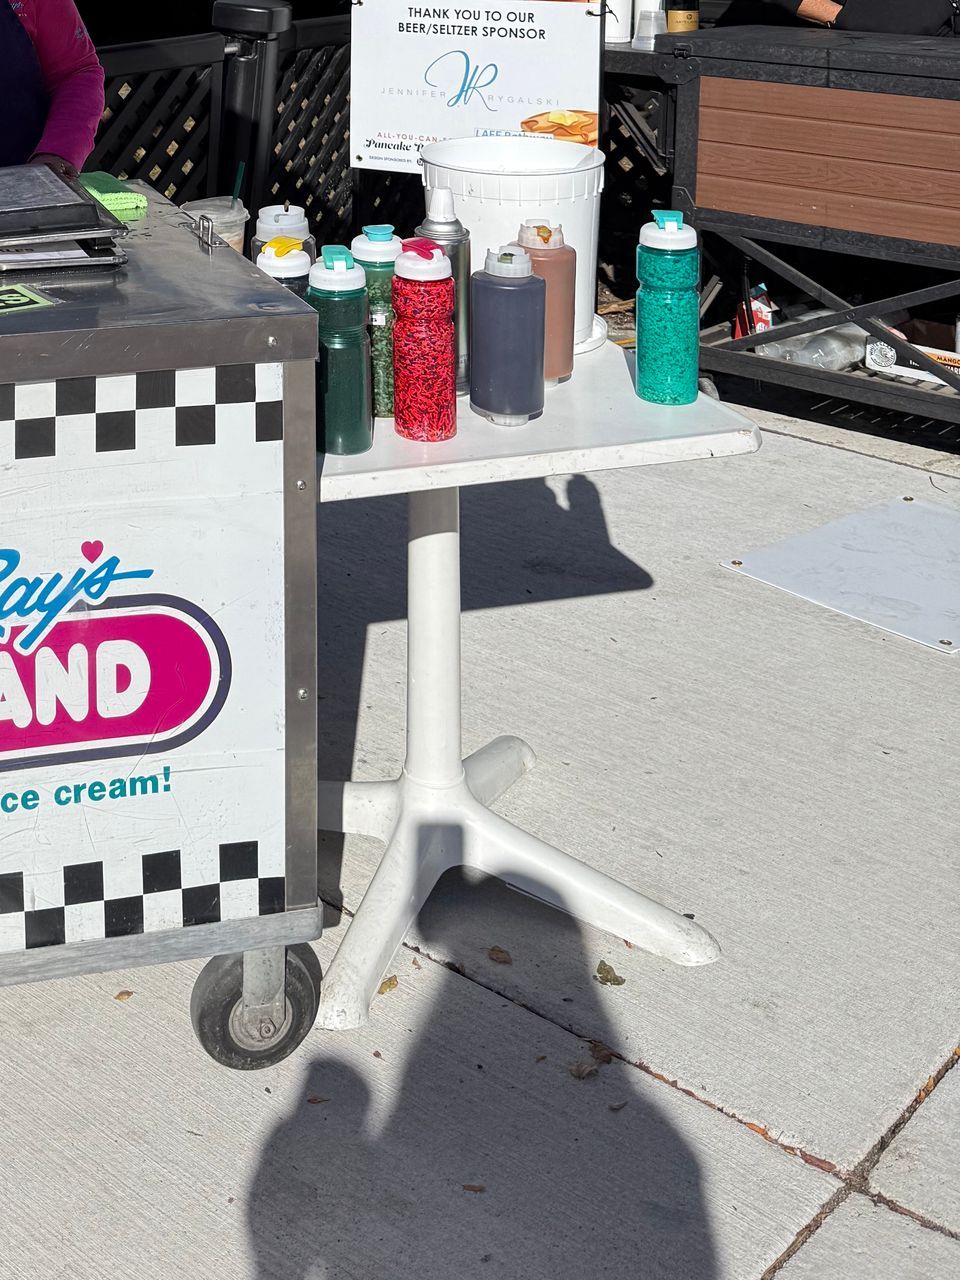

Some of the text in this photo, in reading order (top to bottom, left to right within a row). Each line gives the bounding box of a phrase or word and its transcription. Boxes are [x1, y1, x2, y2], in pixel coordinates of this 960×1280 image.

[408, 7, 535, 23] THANK YOU TO OUR
[398, 22, 546, 39] BEER/SELTZER SPONSOR
[380, 87, 560, 106] JENNIFER RYGALSKI
[365, 138, 412, 151] Pancake
[53, 766, 173, 807] cream!
